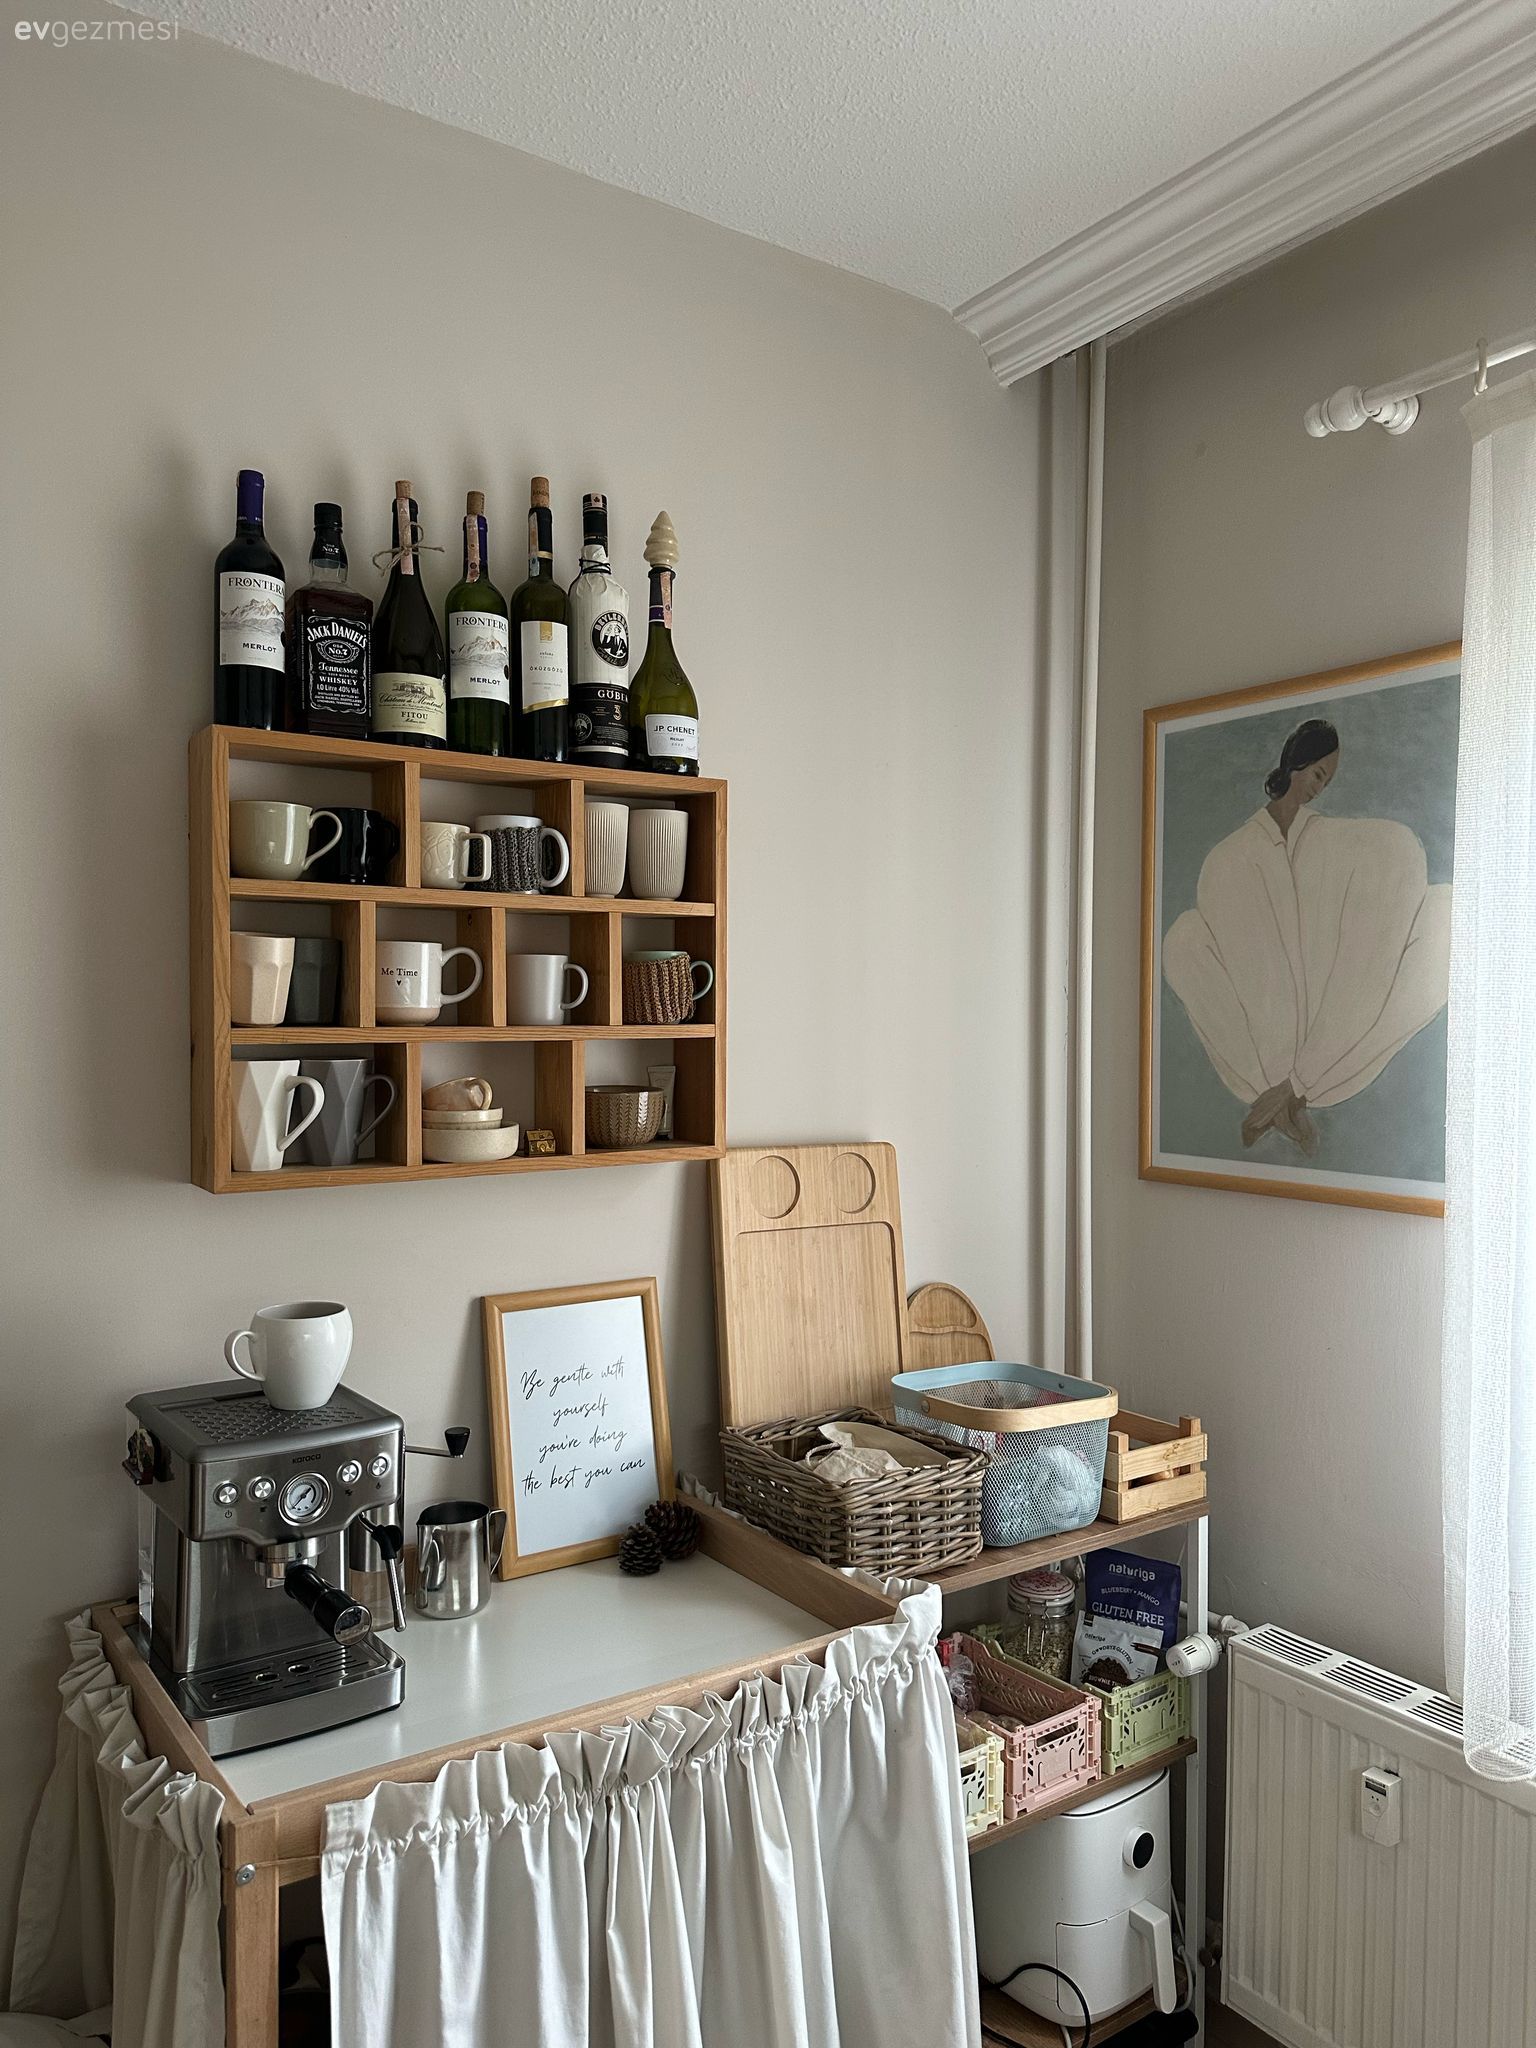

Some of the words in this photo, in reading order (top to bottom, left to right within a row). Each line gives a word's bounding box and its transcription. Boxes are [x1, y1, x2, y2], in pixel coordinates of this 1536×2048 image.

[306, 625, 331, 642] JACK
[331, 621, 368, 649] DANIEL'S
[242, 642, 277, 653] MERLOT
[328, 647, 348, 656] No.7
[318, 661, 359, 675] Tennessee
[319, 675, 358, 686] WHISKEY
[469, 677, 501, 686] MERLOT
[401, 711, 428, 720] FITOU
[666, 725, 695, 736] CHENET
[381, 967, 394, 976] Me
[395, 967, 419, 977] Time
[520, 1369, 545, 1400] Be
[549, 1362, 594, 1397] gentle
[601, 1355, 625, 1380] with
[553, 1392, 608, 1427] yourself
[539, 1435, 581, 1464] you're
[589, 1425, 628, 1452] doing
[292, 1453, 321, 1464] karaca
[521, 1469, 543, 1497] the
[549, 1465, 583, 1489] best
[584, 1465, 612, 1489] you
[620, 1458, 646, 1472] can
[1108, 1563, 1156, 1582] naturiga
[1101, 1586, 1134, 1594] BLUEBERRY
[1137, 1590, 1160, 1606] MANGO
[1091, 1601, 1134, 1619] GLUTEN
[1136, 1610, 1165, 1626] FREE
